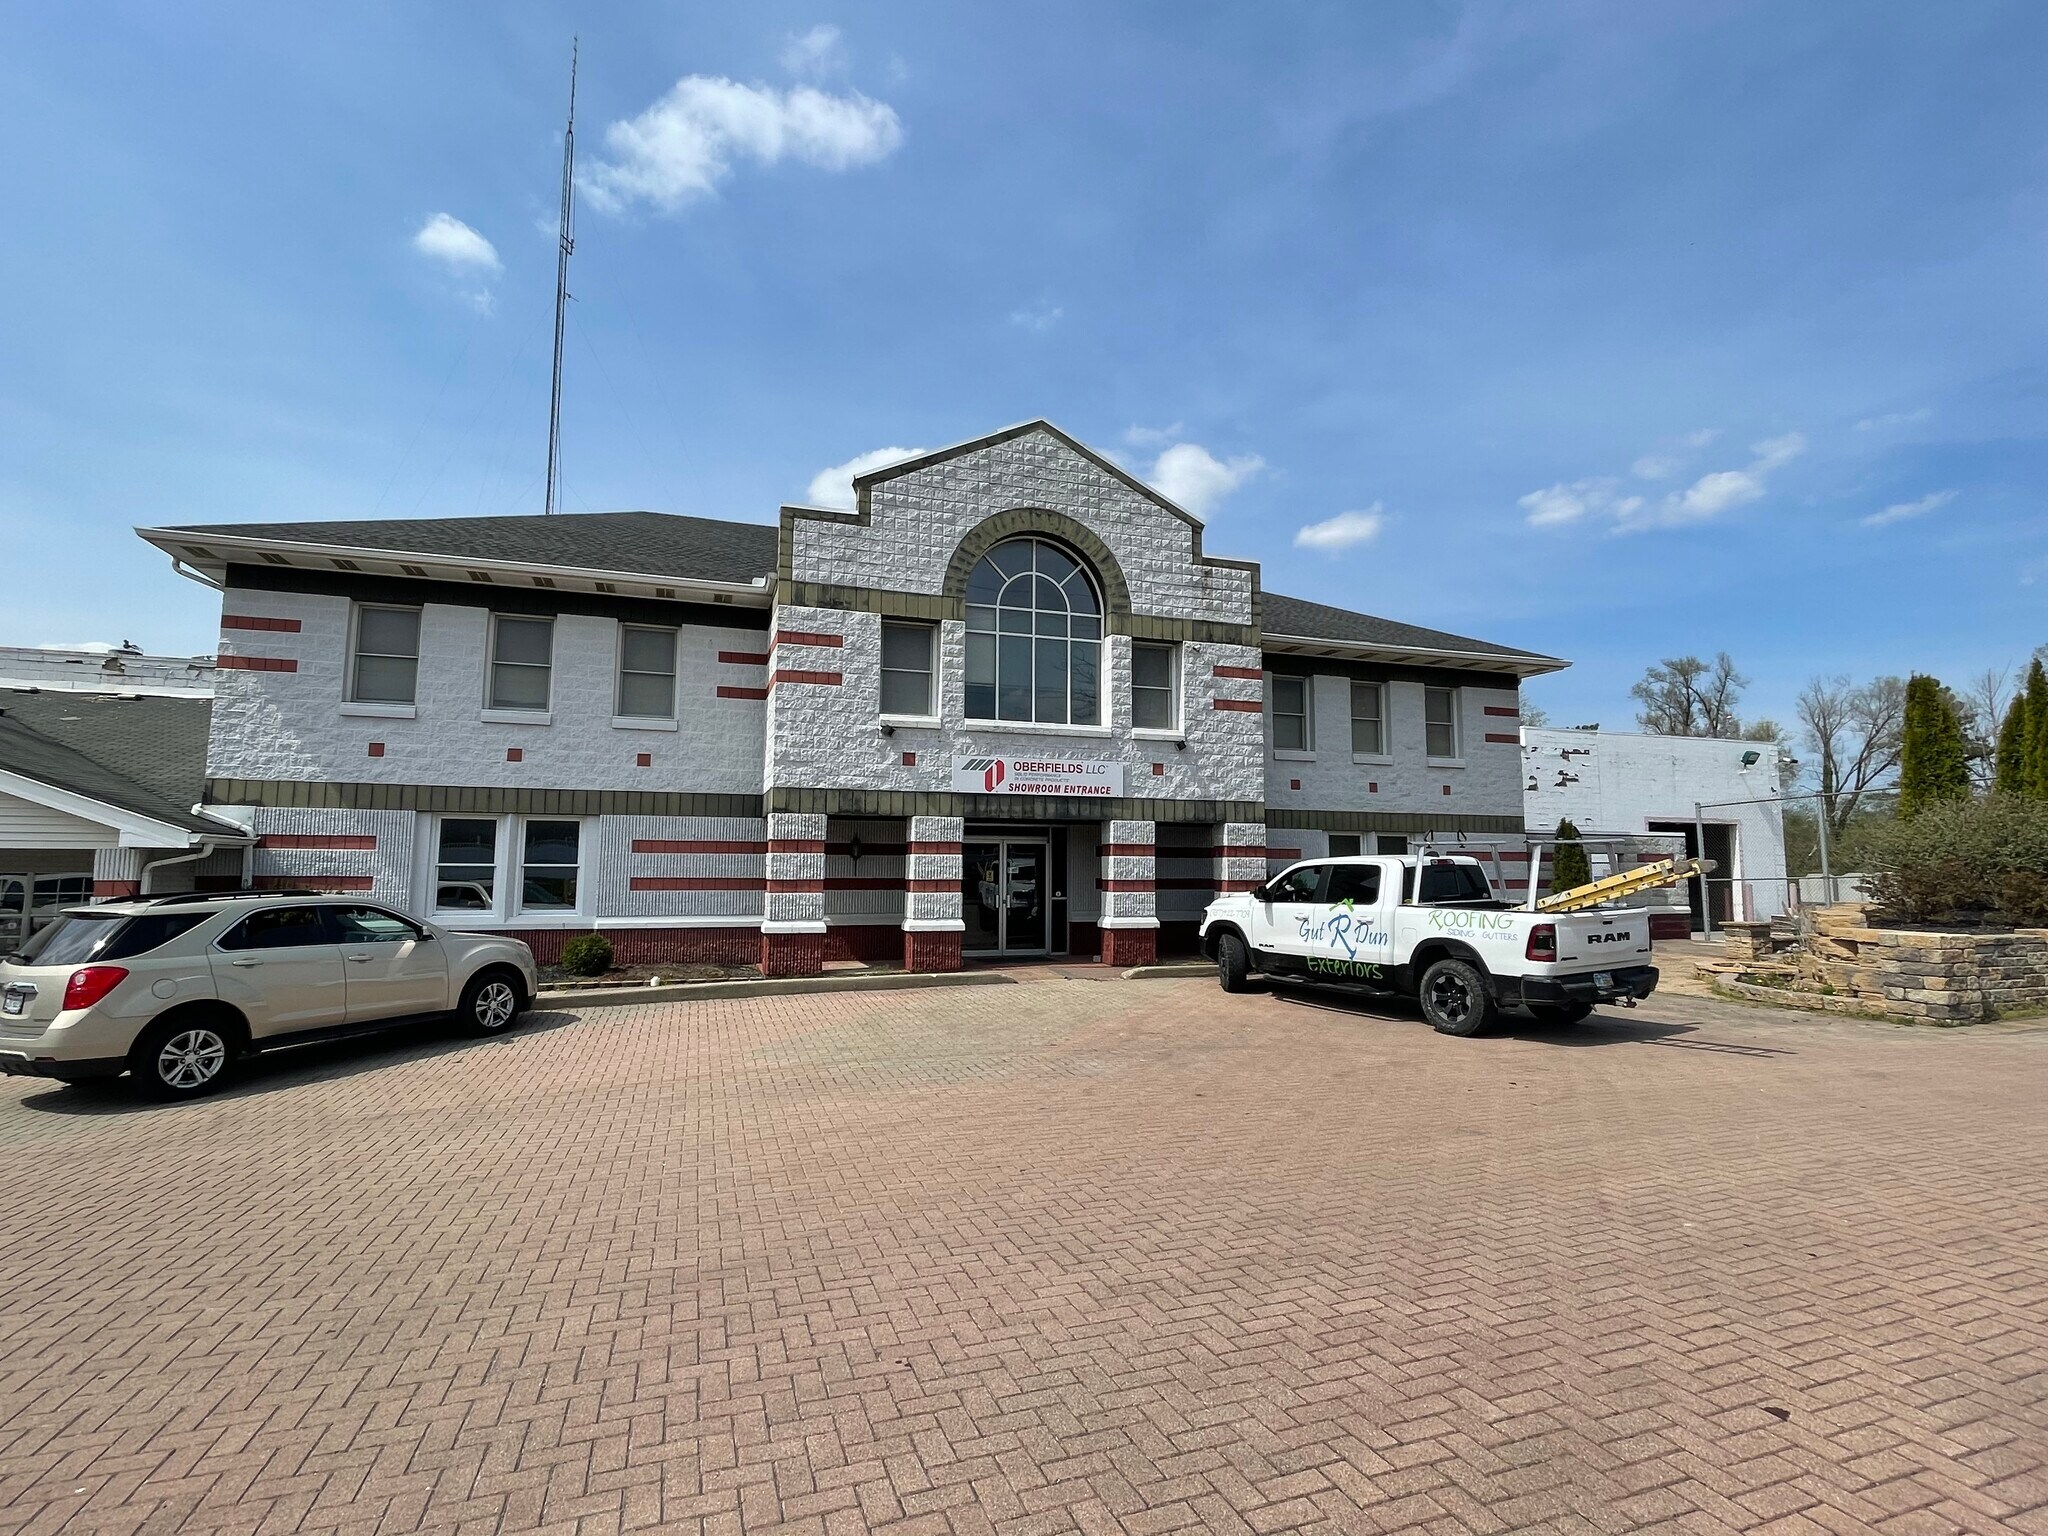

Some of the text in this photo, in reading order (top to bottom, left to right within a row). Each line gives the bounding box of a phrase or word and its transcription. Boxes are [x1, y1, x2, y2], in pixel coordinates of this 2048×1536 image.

[1013, 761, 1106, 775] OBERFIELDS LLC
[1008, 783, 1112, 795] SHOWROOM ENTRANCE
[1428, 910, 1515, 931] ROOFING
[1299, 913, 1388, 961] Gut R Dun
[1446, 927, 1519, 941] SIDING GUTTERS
[1587, 931, 1631, 944] RAM
[1306, 955, 1384, 979] Exteriors
